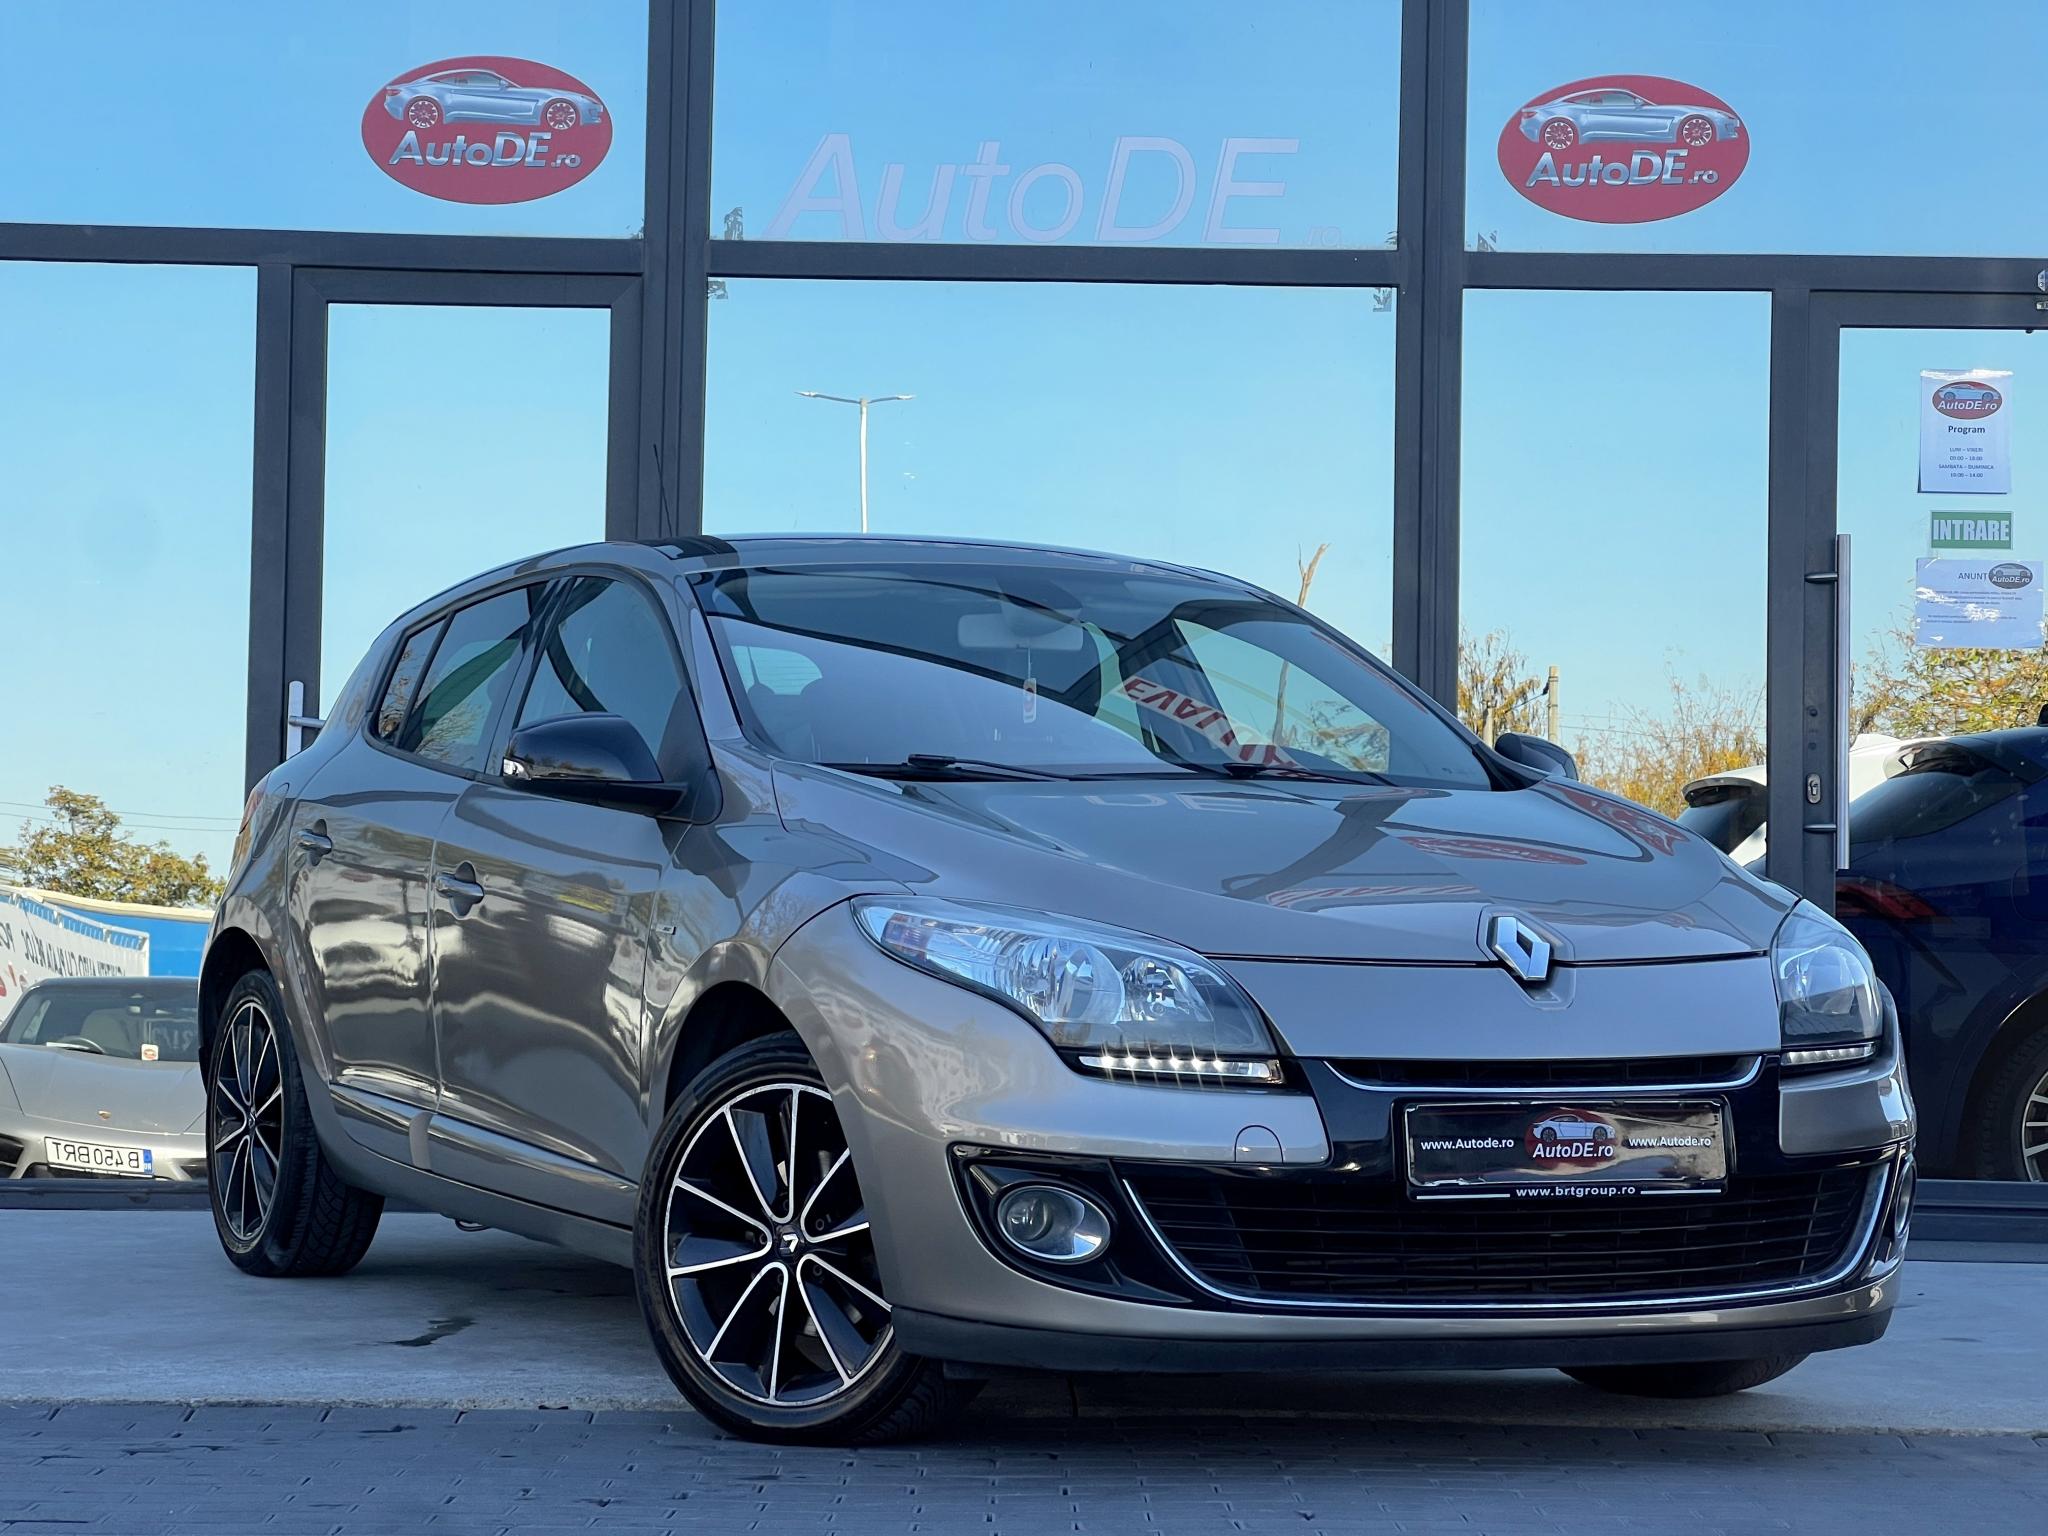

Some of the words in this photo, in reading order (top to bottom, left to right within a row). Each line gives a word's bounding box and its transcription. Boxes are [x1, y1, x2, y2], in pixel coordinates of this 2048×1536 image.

[388, 131, 581, 168] AutoDE.ro
[1525, 149, 1719, 188] AutoDE.ro
[1938, 400, 1998, 410] AutoDE.ro
[1948, 425, 1986, 435] Program
[1933, 519, 2010, 541] INTRARE
[1420, 1137, 1514, 1150] www.Autode.ro
[1628, 1135, 1712, 1147] www.Autode.ro
[1532, 1142, 1614, 1159] AutoDE.ro
[1516, 1185, 1636, 1198] www.brtgroup.ro
